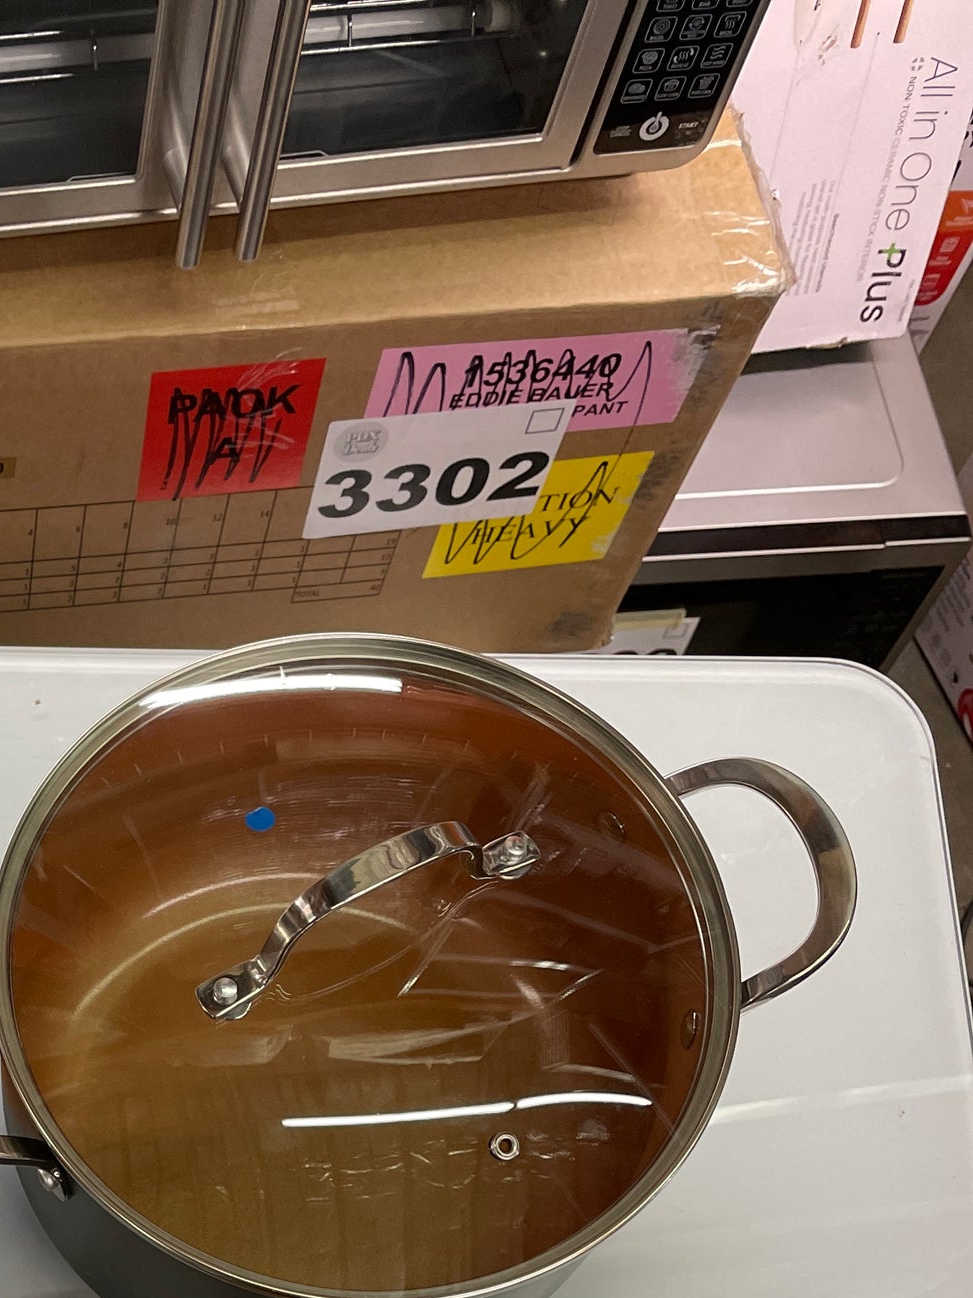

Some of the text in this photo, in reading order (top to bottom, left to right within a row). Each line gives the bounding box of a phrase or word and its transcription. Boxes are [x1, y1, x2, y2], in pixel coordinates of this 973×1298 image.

[921, 56, 959, 97] All
[909, 110, 949, 140] in
[885, 152, 932, 231] One
[448, 382, 615, 410] EDDIE BAUER
[570, 400, 628, 418] PANT
[318, 451, 550, 519] 3302
[470, 515, 589, 546] HEAVY
